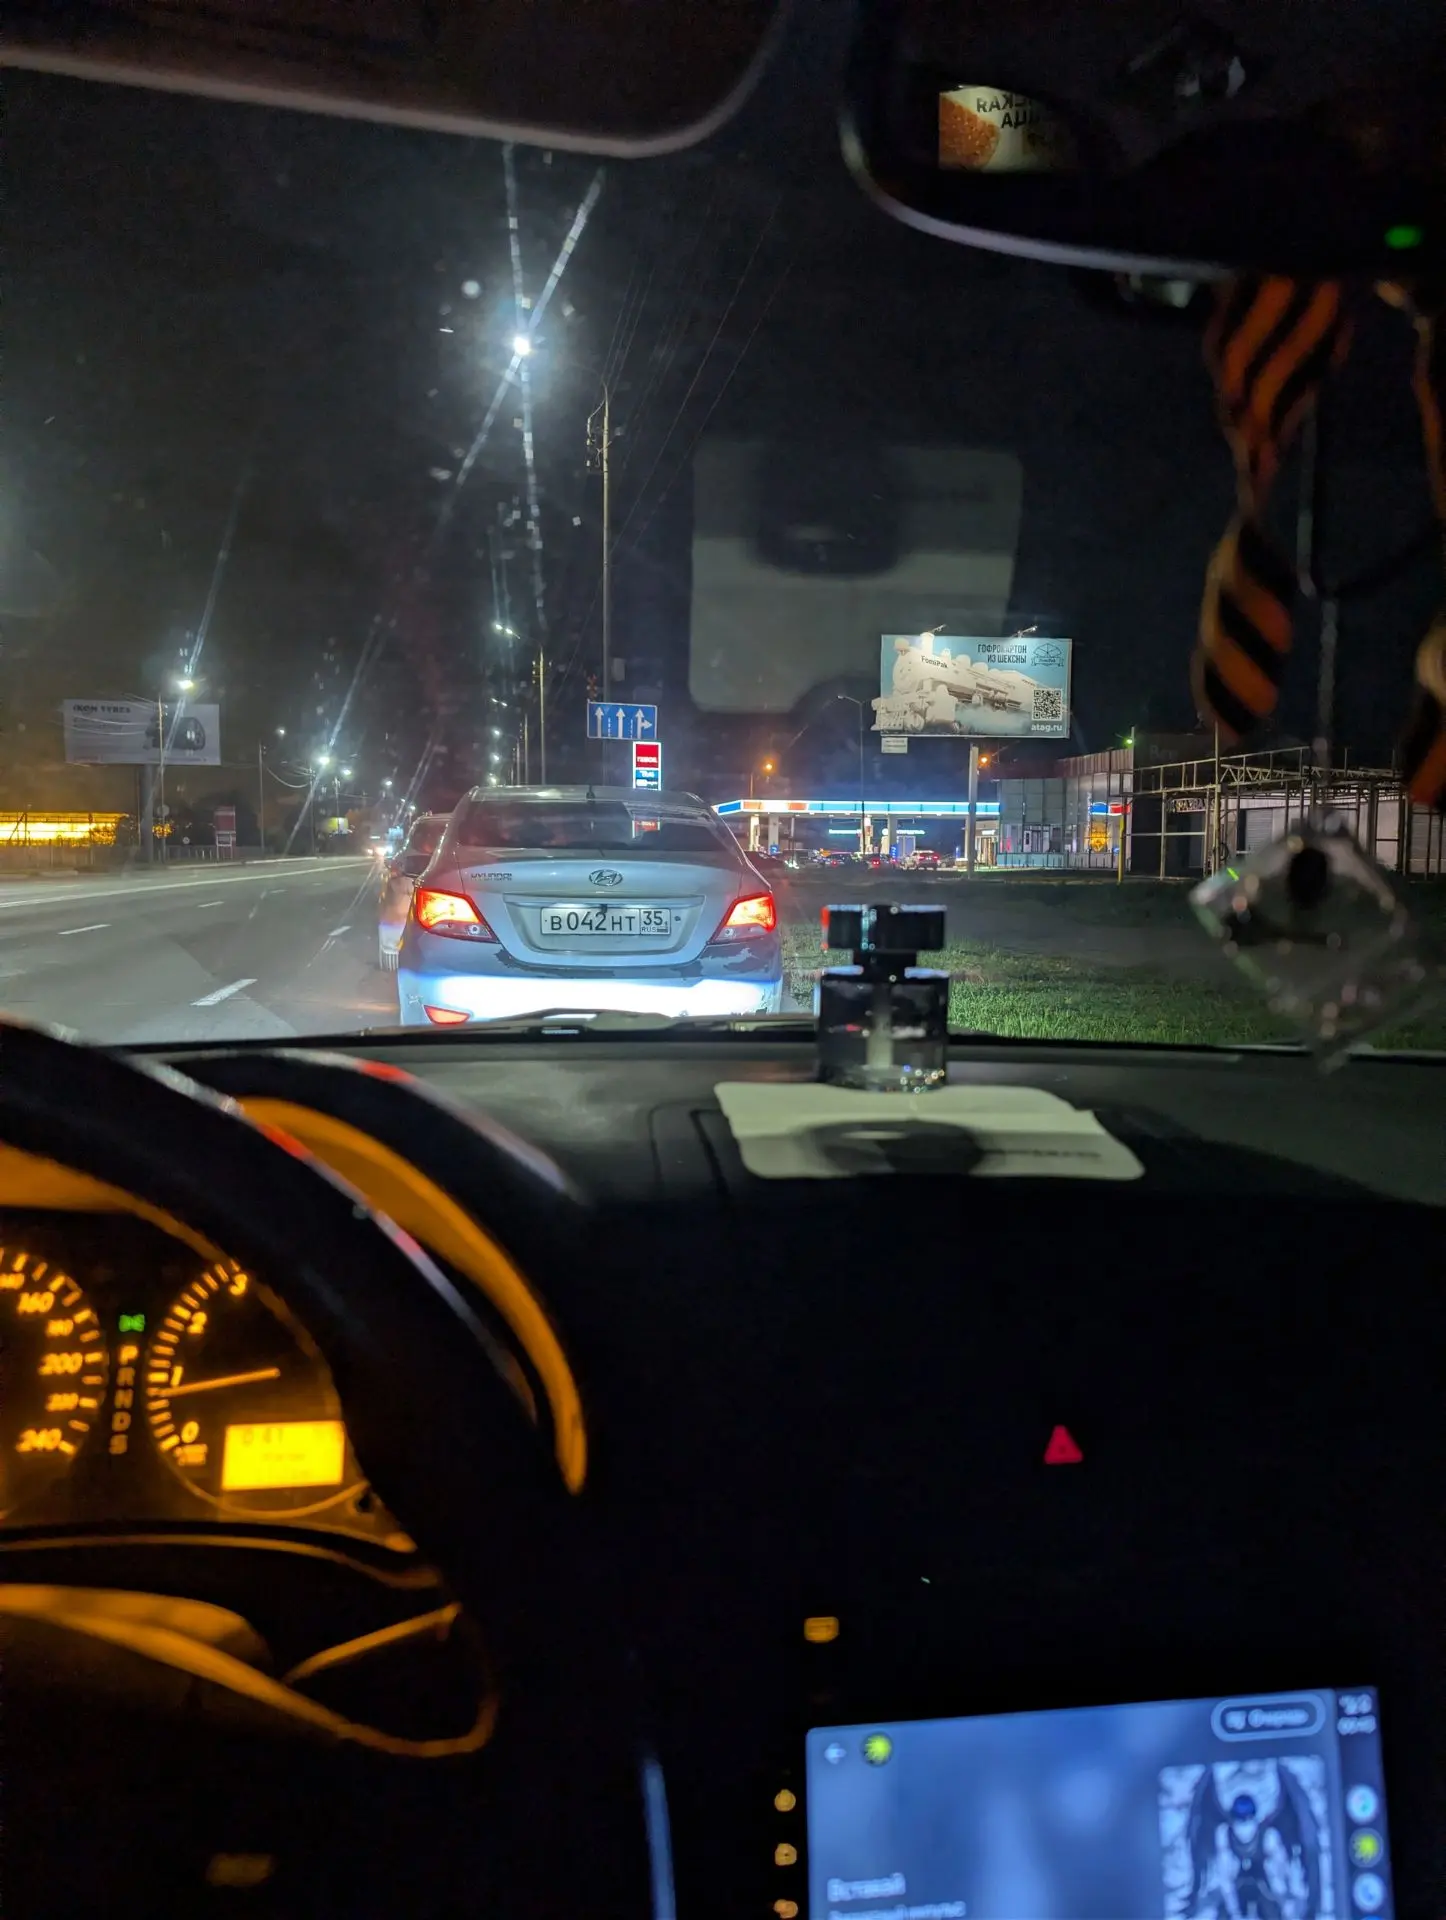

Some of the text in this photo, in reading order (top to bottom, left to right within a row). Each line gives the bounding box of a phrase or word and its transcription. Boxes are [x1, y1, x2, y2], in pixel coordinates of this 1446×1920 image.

[987, 654, 1027, 664] ИЗ ШЕКСНЫ
[1031, 723, 1063, 732] atag.ru
[643, 911, 662, 926] 35
[181, 1421, 200, 1444] 0
